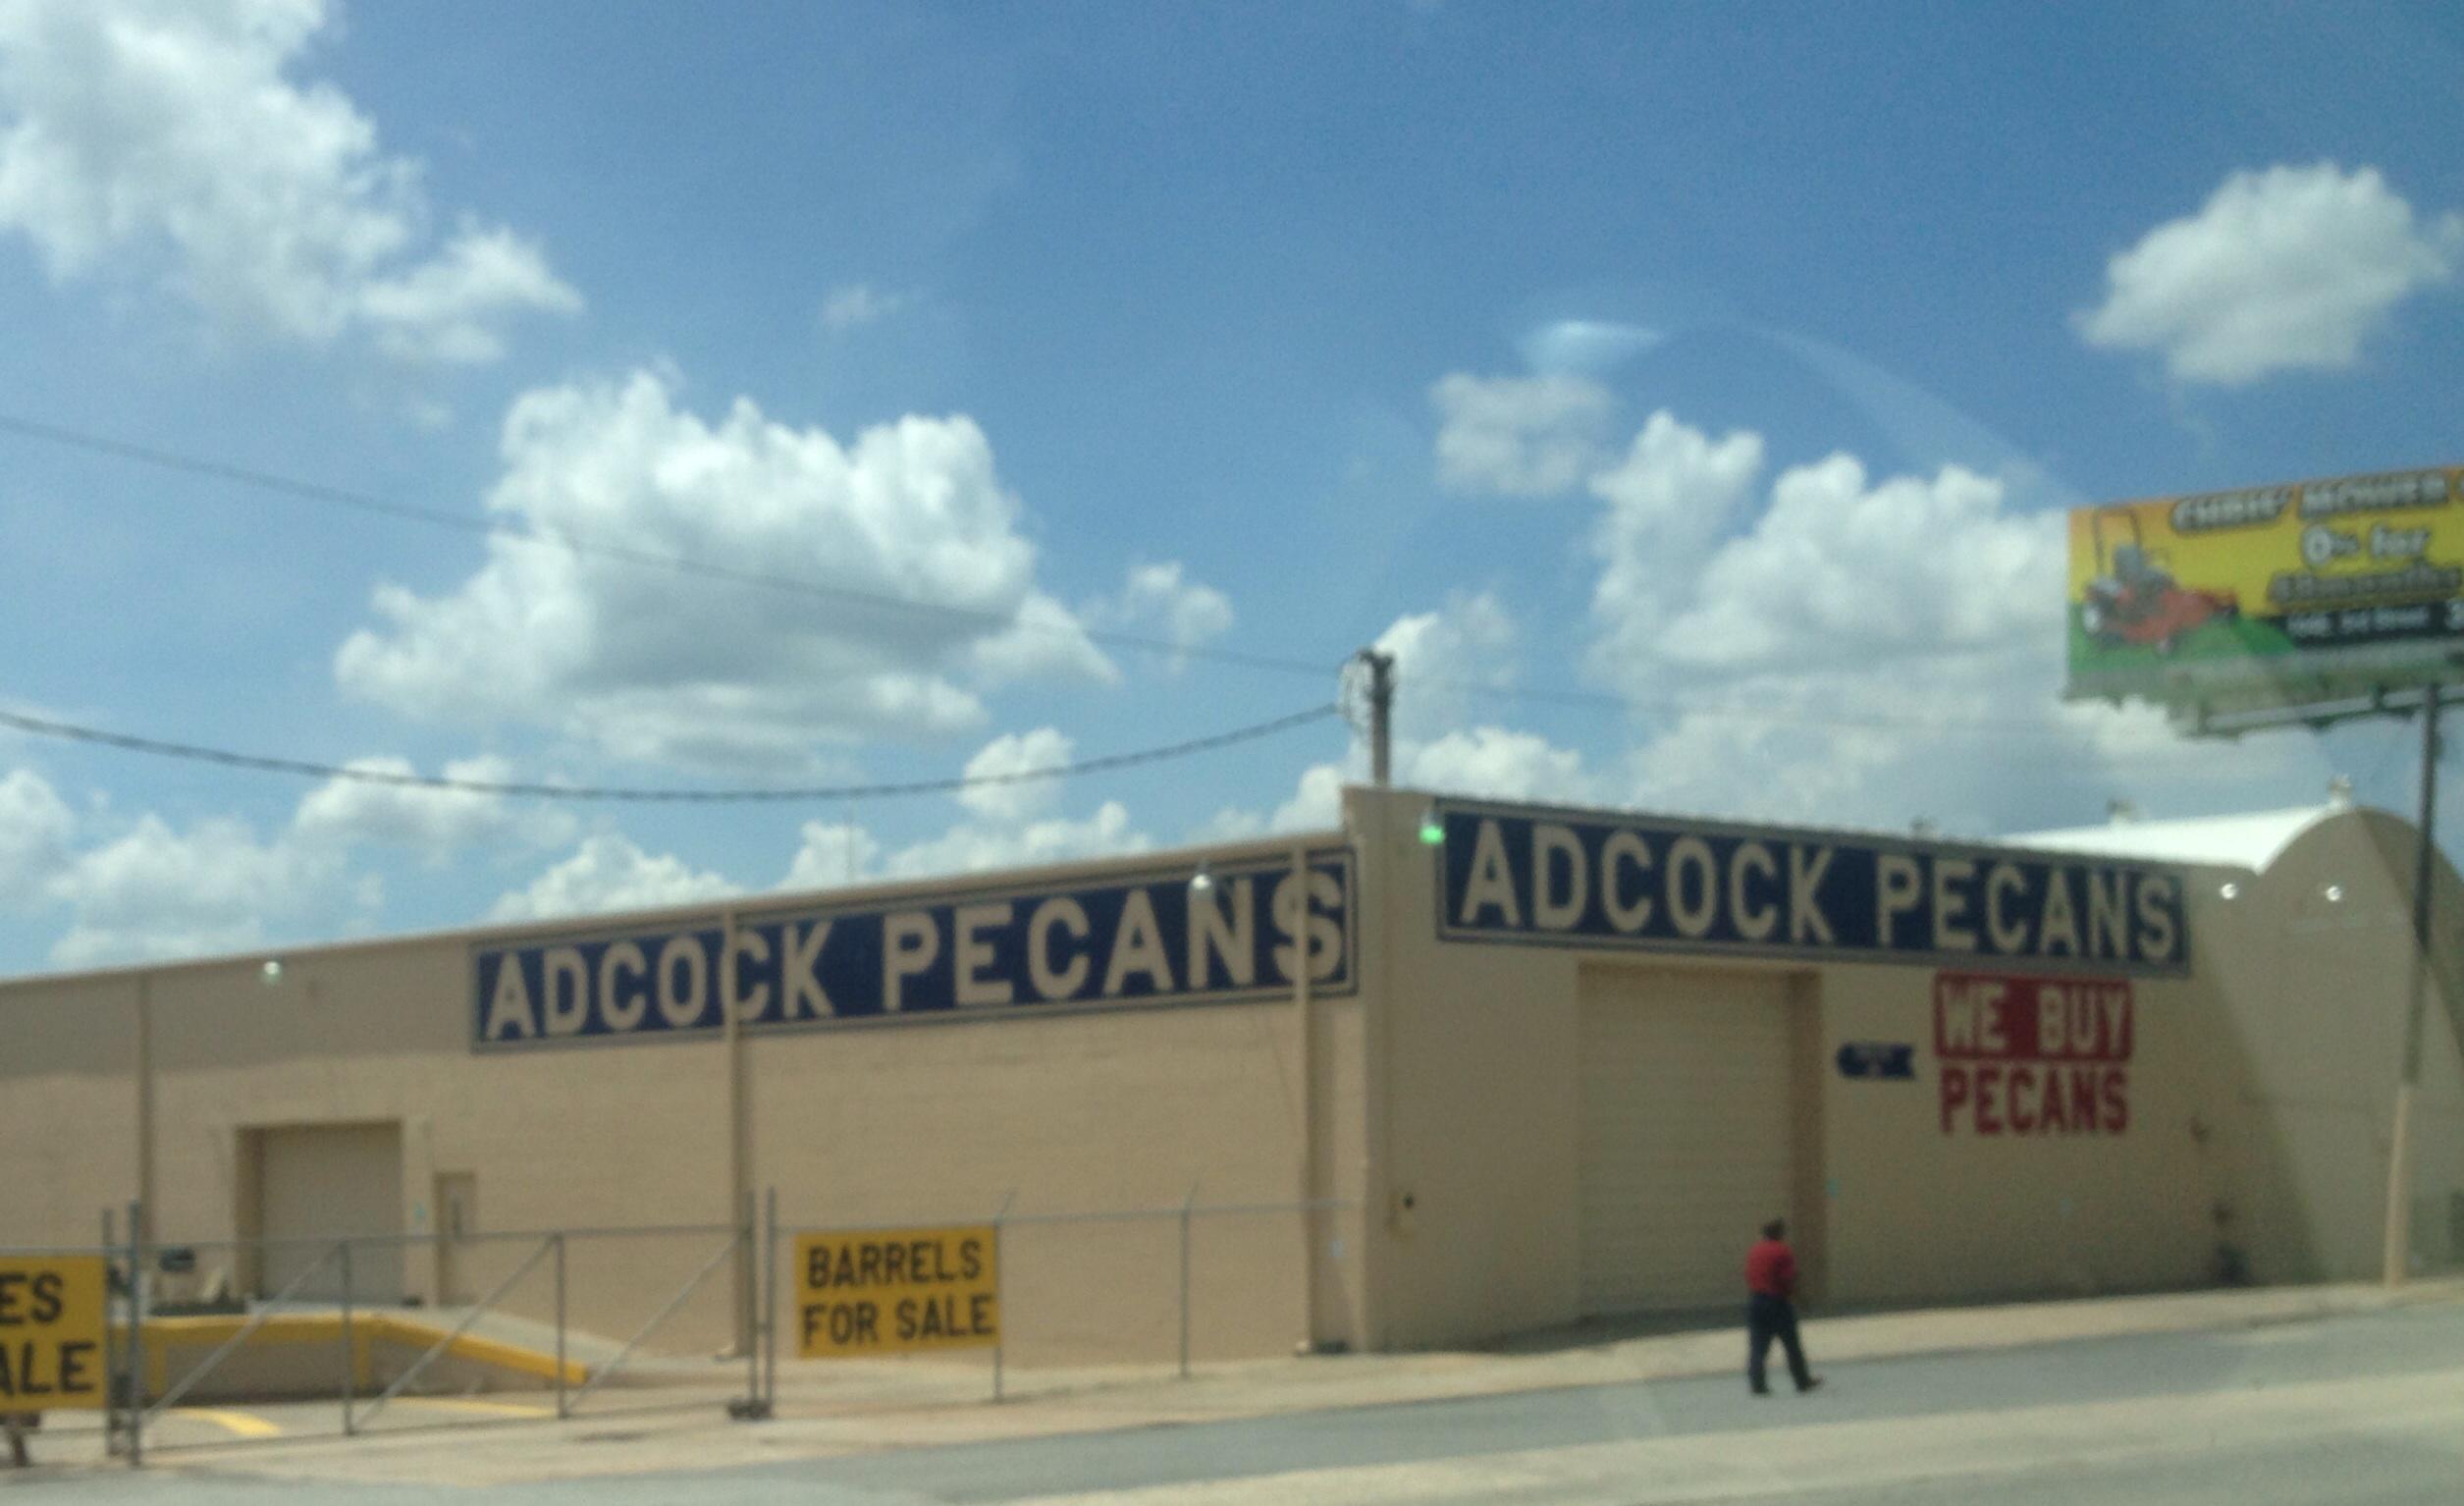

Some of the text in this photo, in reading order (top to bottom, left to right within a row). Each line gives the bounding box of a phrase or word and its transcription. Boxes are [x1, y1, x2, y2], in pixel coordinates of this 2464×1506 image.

[1460, 817, 2173, 960] ADCOCK PECANS
[485, 869, 1343, 1040] ADCOCK PECANS
[1940, 982, 2128, 1054] WE BUY
[1939, 1066, 2128, 1136] PECANS
[807, 1240, 983, 1289] BARRELS
[802, 1293, 995, 1347] FOR SALE
